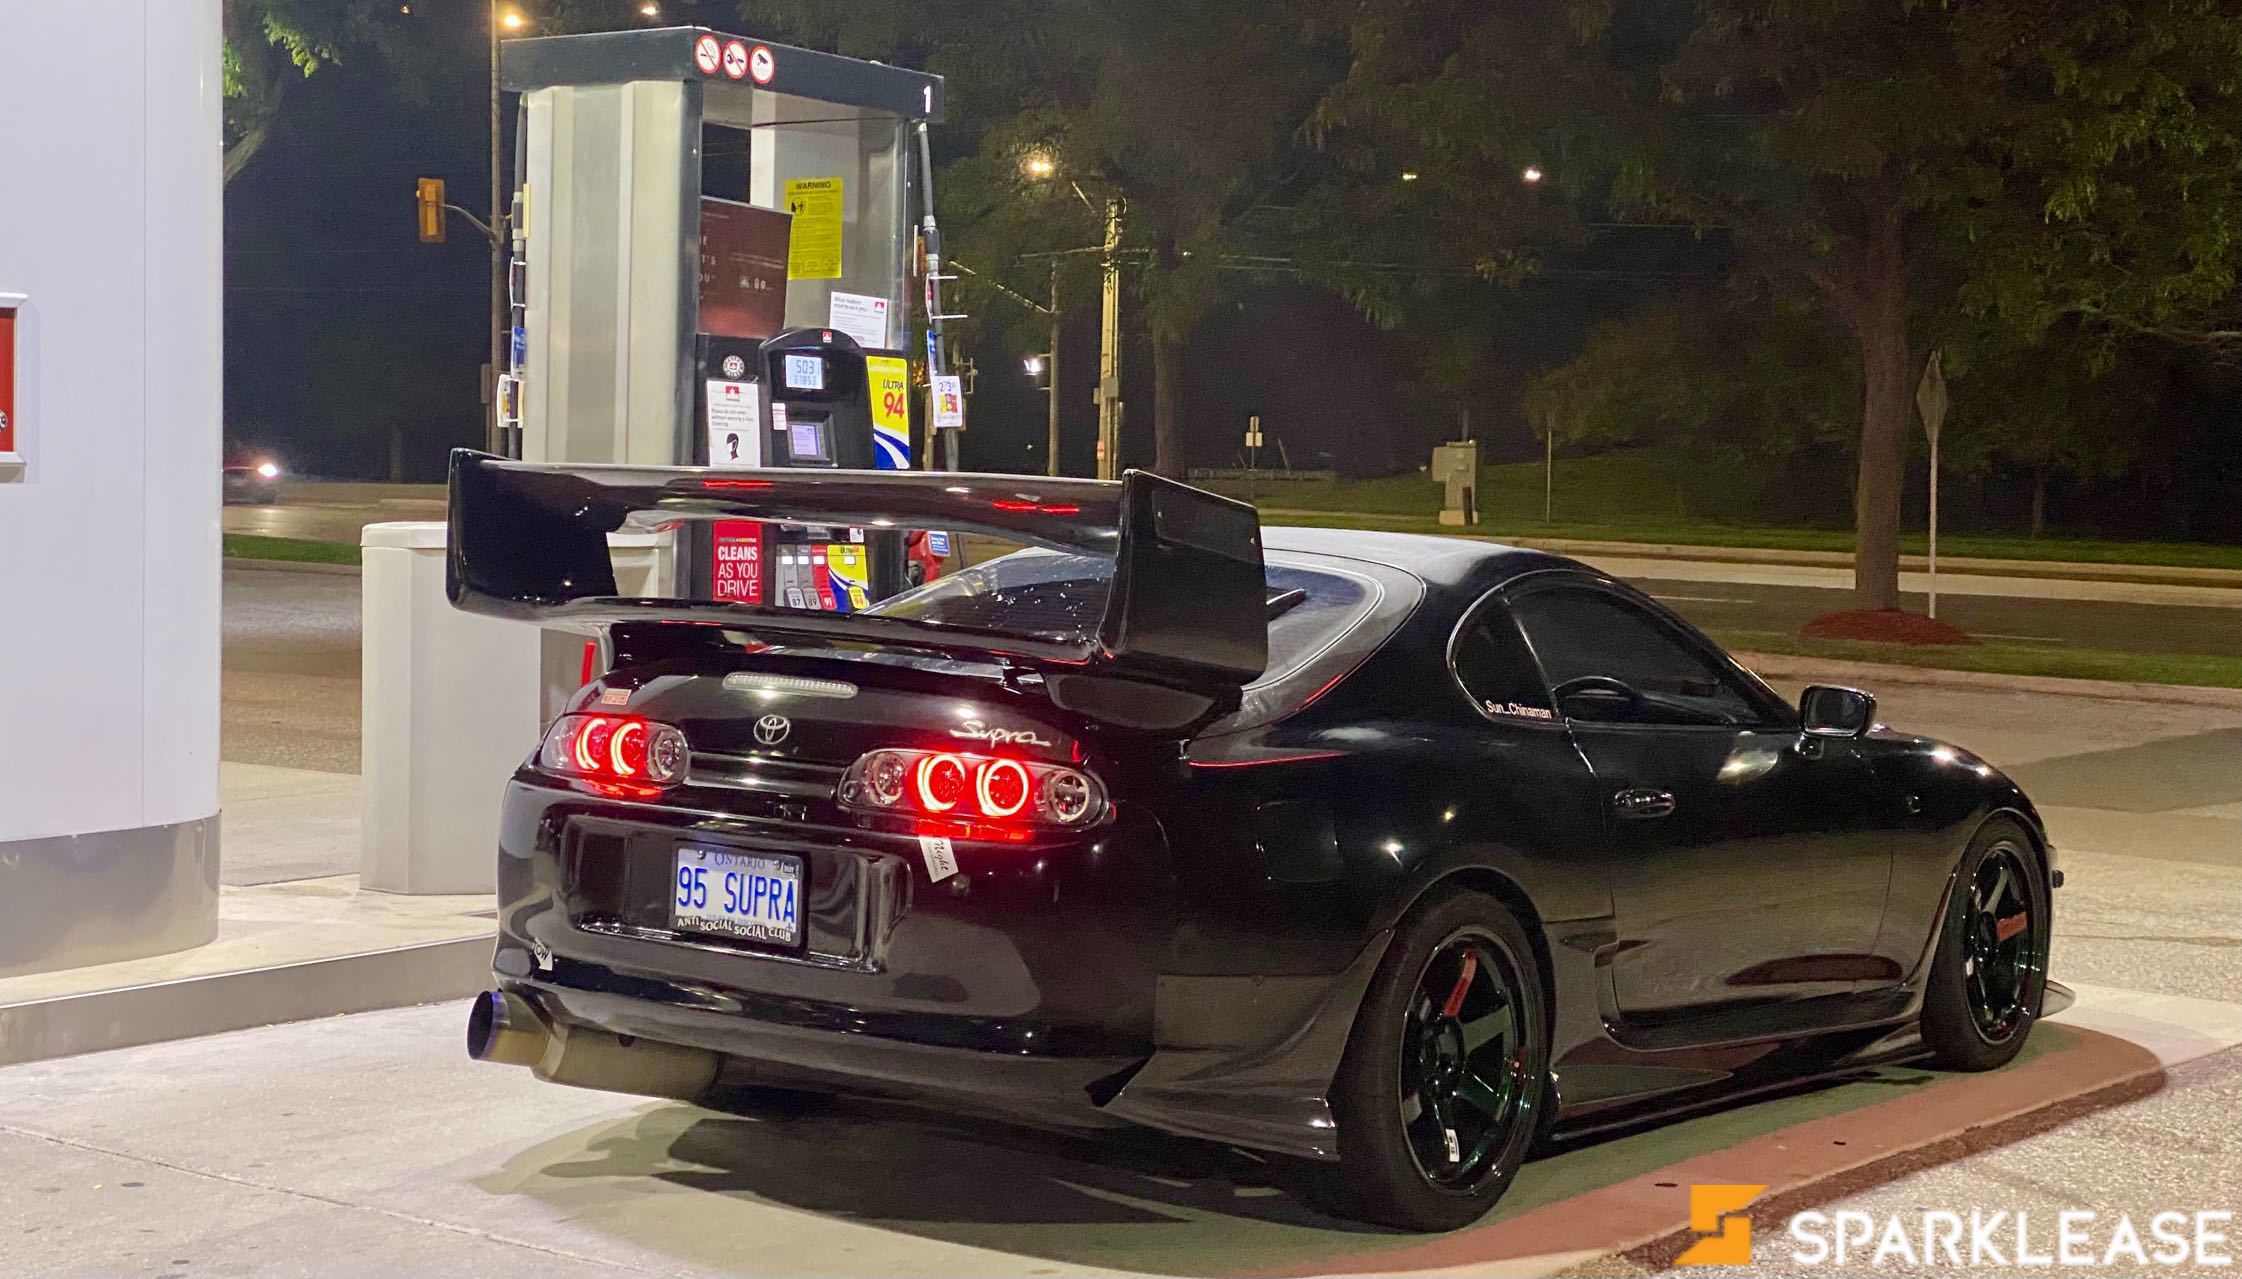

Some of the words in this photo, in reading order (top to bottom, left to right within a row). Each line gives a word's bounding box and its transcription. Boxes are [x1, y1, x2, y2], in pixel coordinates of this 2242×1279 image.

[923, 85, 931, 113] 1
[883, 378, 904, 390] ULTRA
[883, 391, 905, 419] 94
[718, 546, 758, 561] CLEANS
[718, 562, 734, 579] AS
[736, 562, 758, 579] YOU
[717, 579, 759, 597] DRIVE
[949, 720, 1052, 749] Supra
[677, 866, 708, 909] 95
[723, 871, 796, 924] SUPRA
[677, 916, 700, 928] ANTI
[699, 918, 733, 932] SOCIAL
[733, 923, 768, 940] SOCIAL
[768, 926, 792, 942] CLUB
